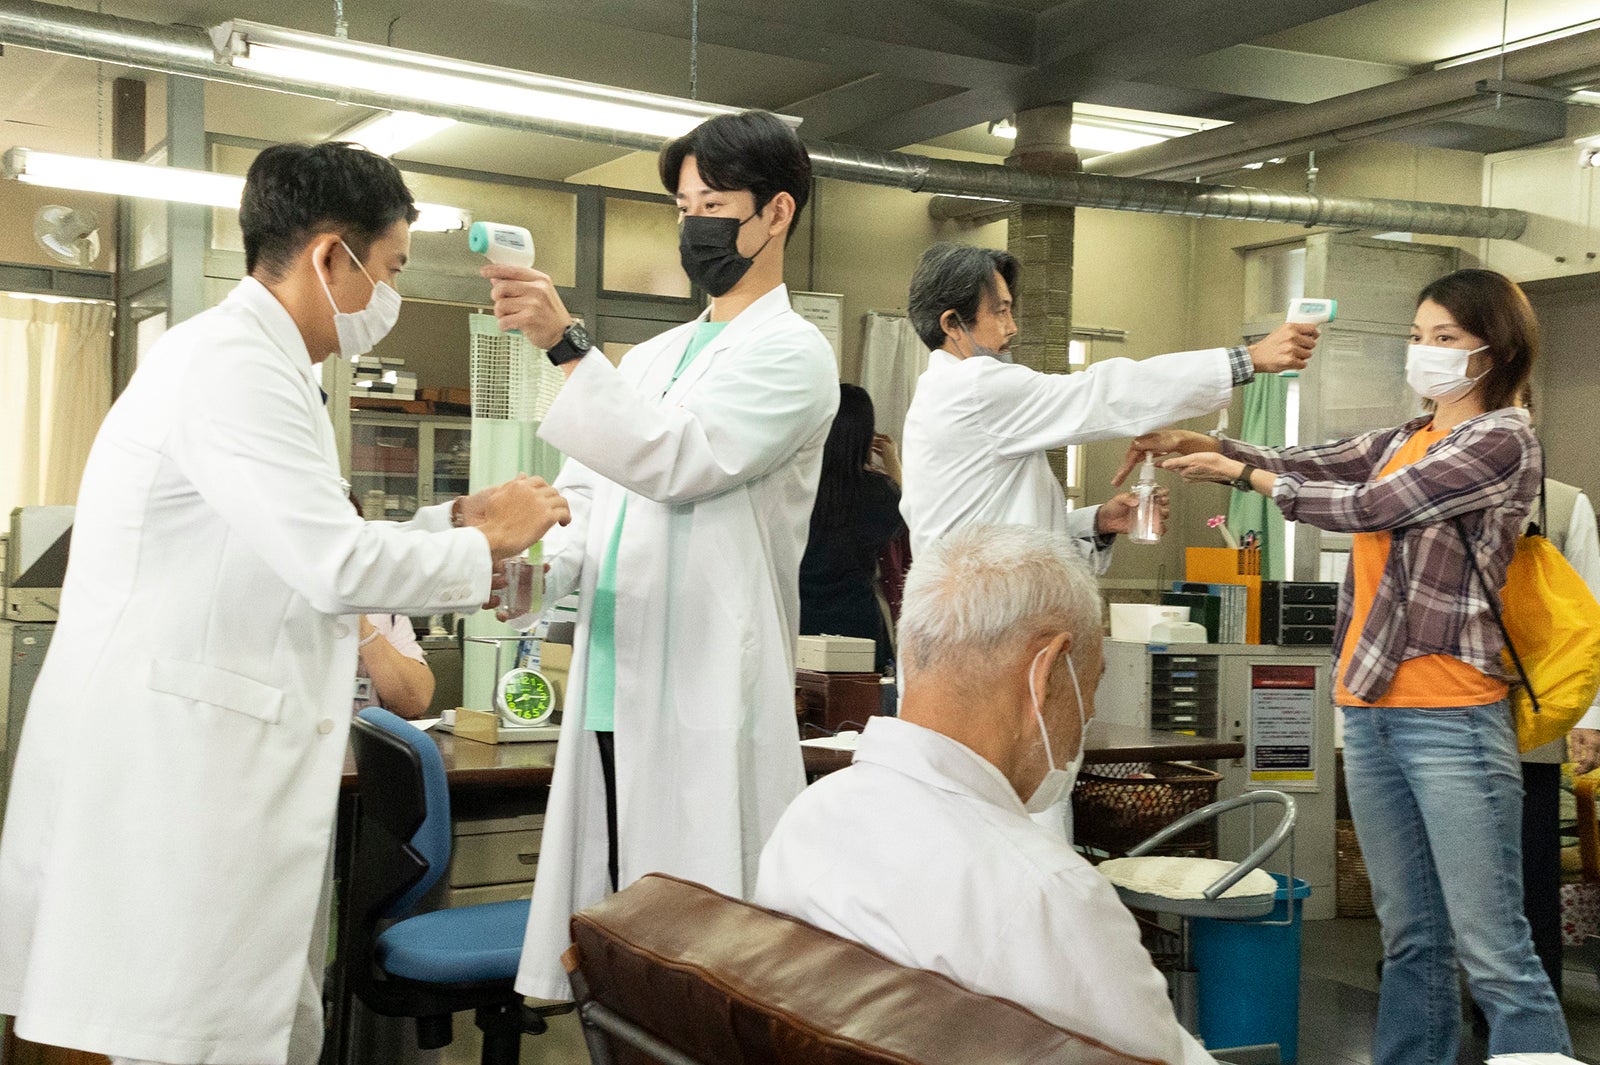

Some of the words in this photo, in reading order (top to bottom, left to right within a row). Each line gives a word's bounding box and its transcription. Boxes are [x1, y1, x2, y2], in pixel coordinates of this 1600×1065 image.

[537, 683, 545, 692] 2
[523, 710, 532, 719] 6
[532, 708, 540, 717] 5
